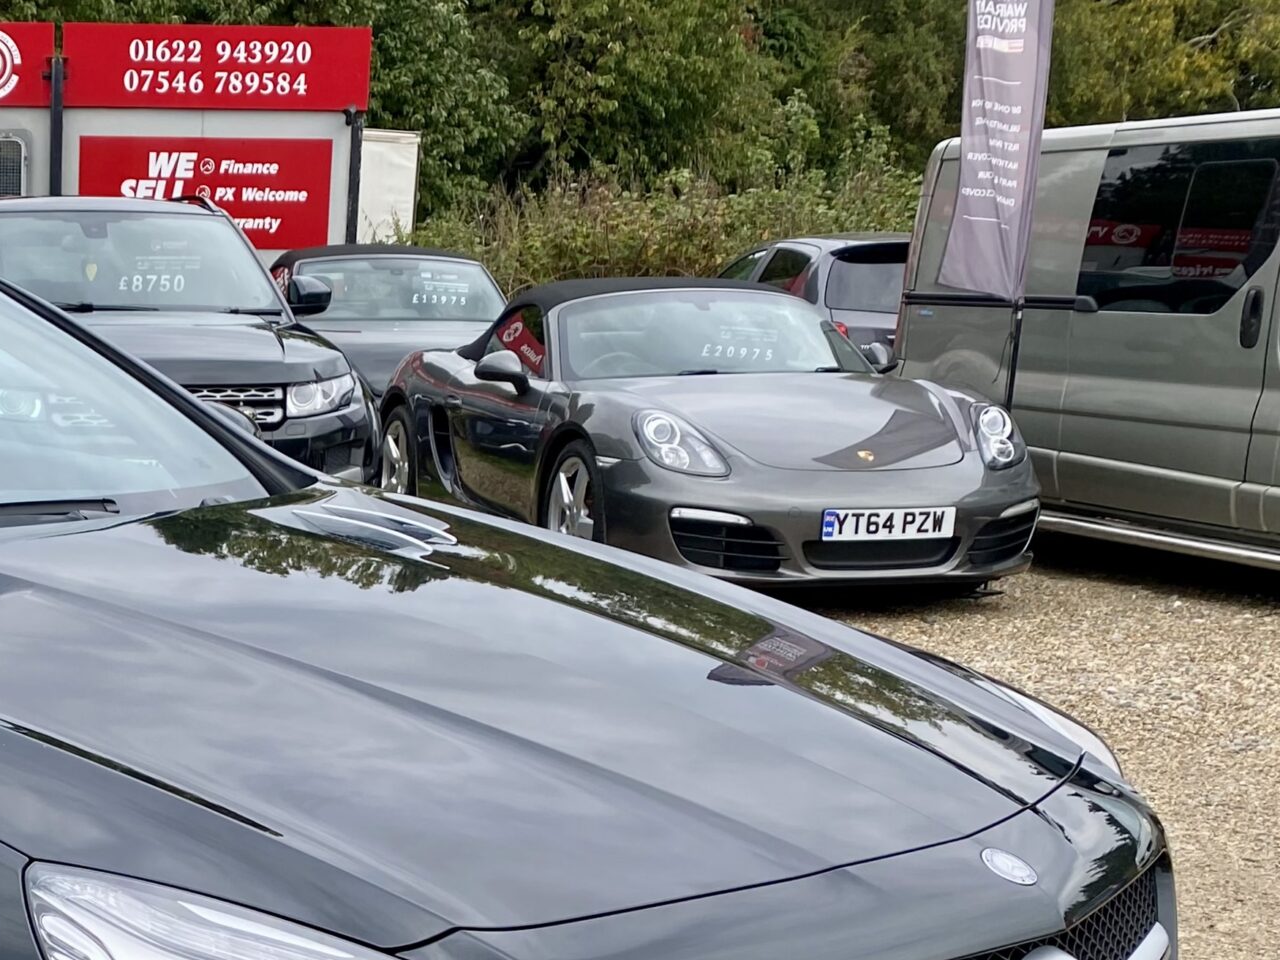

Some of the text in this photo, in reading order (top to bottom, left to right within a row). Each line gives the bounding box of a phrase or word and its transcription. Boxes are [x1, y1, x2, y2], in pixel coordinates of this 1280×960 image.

[129, 39, 312, 64] 01622 943920
[123, 69, 308, 95] 07546 789584
[148, 152, 198, 179] WE
[219, 159, 279, 175] Finance
[214, 187, 308, 202] PX Welcome
[232, 216, 281, 233] rranty
[119, 275, 185, 292] £8750
[412, 293, 466, 306] £13975
[701, 344, 773, 361] £20975
[836, 512, 895, 535] YT64
[901, 510, 945, 534] PZW
